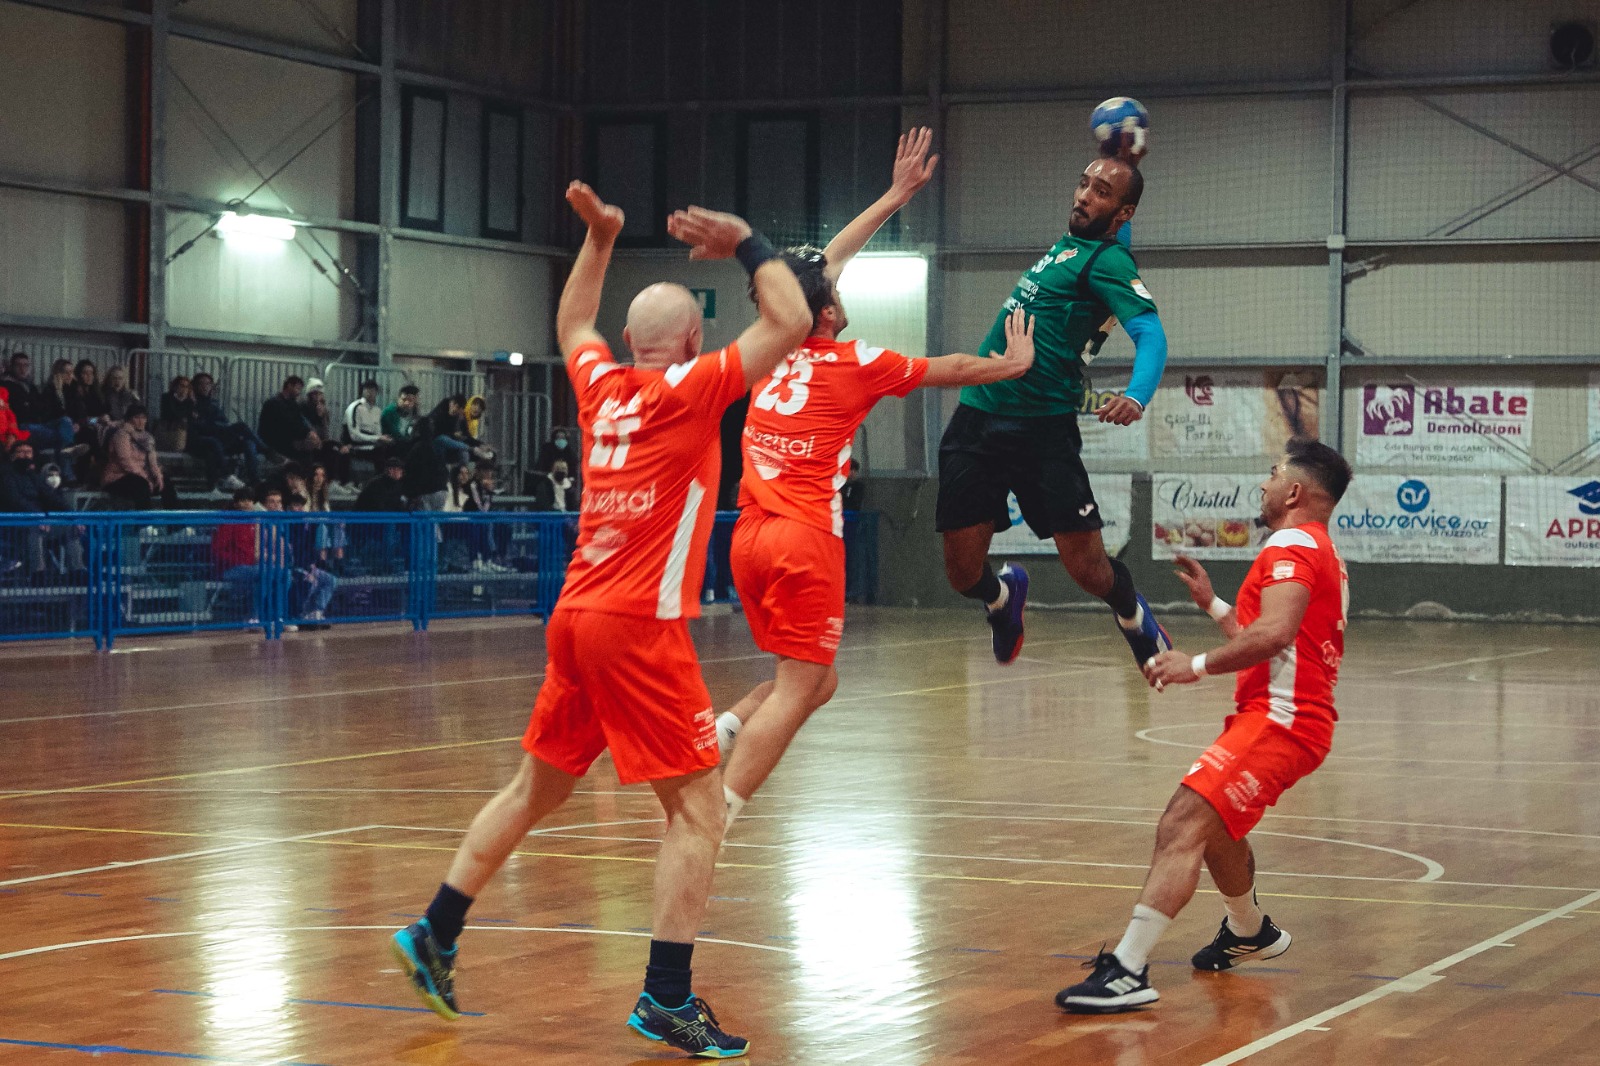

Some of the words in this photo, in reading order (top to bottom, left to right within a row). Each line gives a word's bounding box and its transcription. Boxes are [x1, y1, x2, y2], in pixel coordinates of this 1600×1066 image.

[754, 360, 814, 416] 23
[1423, 385, 1528, 416] Abate
[1427, 421, 1522, 436] Demolizioni
[1158, 479, 1241, 511] Cristal
[1337, 509, 1461, 529] autoservice
